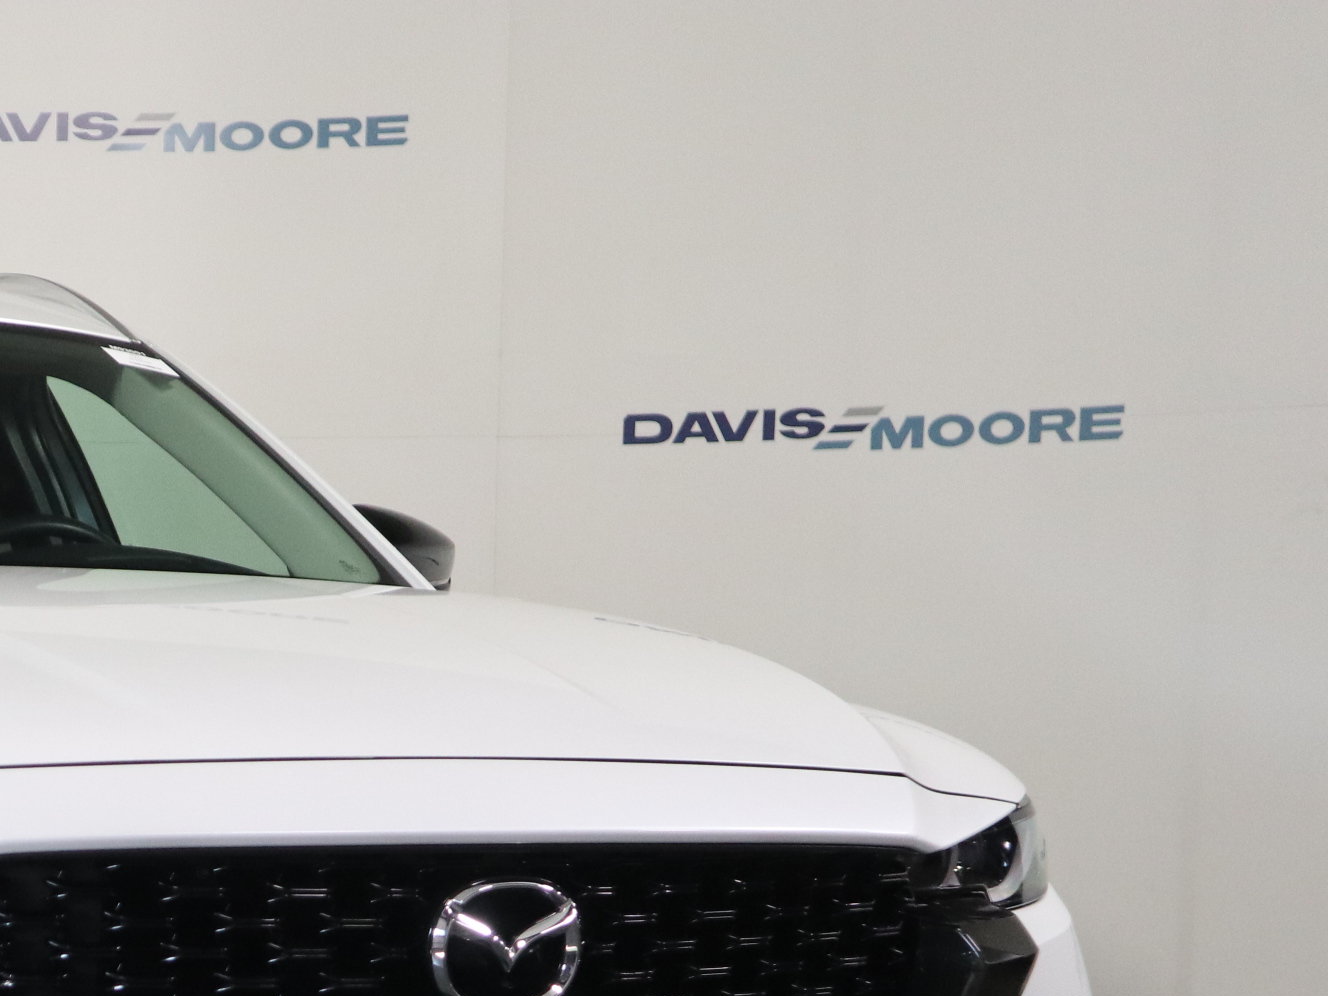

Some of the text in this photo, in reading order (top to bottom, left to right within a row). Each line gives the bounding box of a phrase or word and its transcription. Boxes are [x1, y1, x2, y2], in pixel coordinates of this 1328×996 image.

[162, 115, 410, 152] MOORE
[622, 405, 1126, 450] DAVIS MOORE
